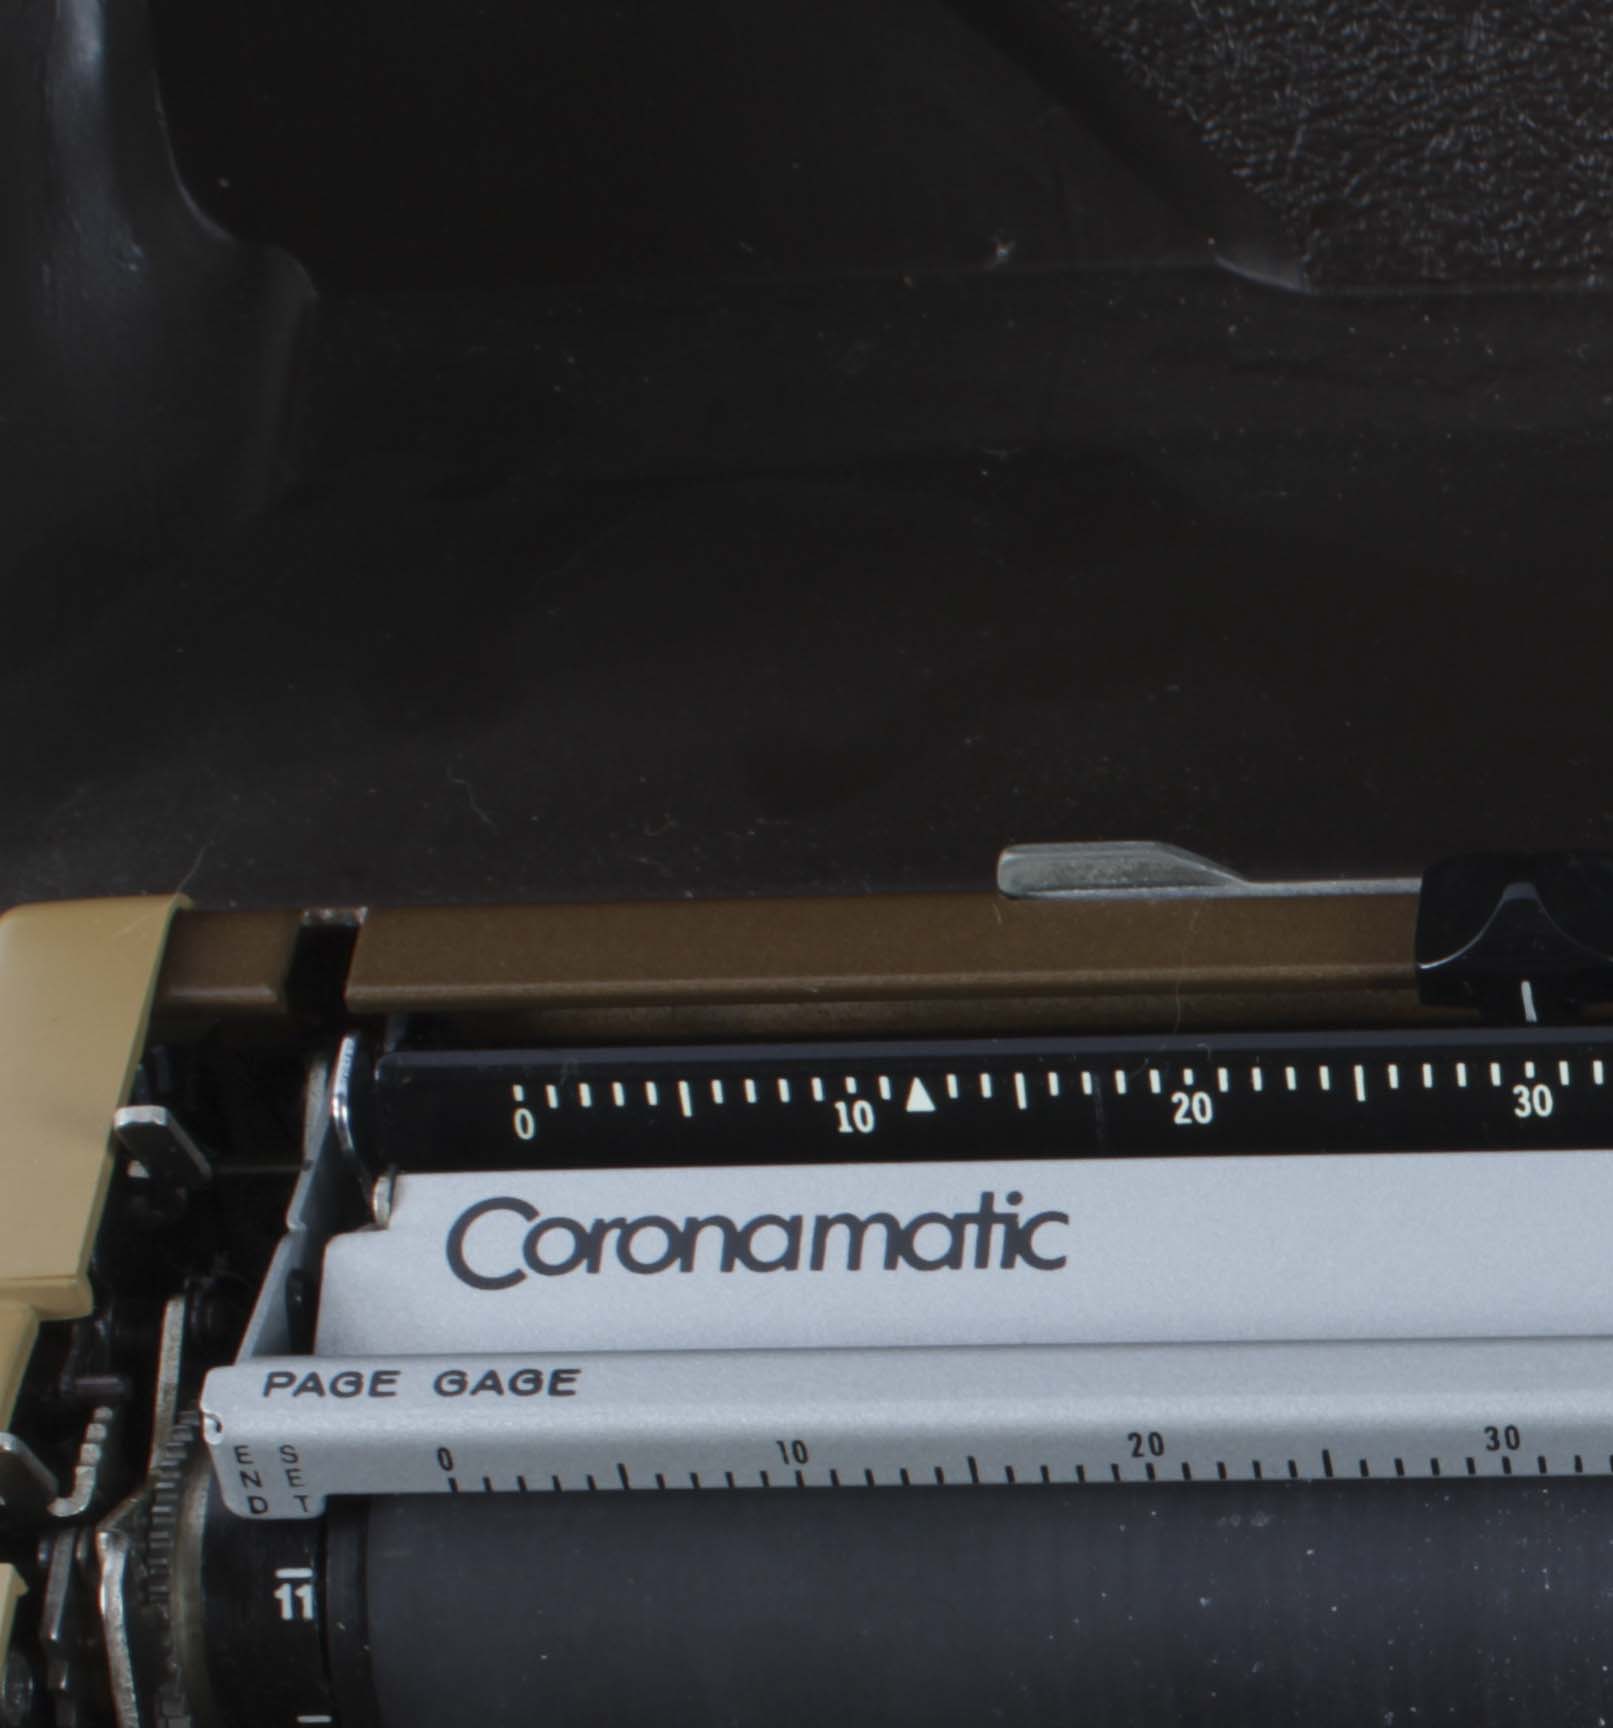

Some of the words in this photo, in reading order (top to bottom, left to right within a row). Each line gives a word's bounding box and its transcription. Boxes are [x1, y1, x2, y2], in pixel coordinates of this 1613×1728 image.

[513, 1107, 535, 1140] 0
[834, 1099, 875, 1133] 10
[1171, 1091, 1213, 1125] 20
[1512, 1083, 1554, 1118] 30
[445, 1190, 1070, 1291] Coronamatic
[262, 1369, 401, 1399] PAGE
[433, 1368, 582, 1398] GAGE
[436, 1446, 454, 1473] 0
[775, 1439, 809, 1465] 10
[1127, 1431, 1165, 1459] 20
[1483, 1424, 1521, 1452] 30
